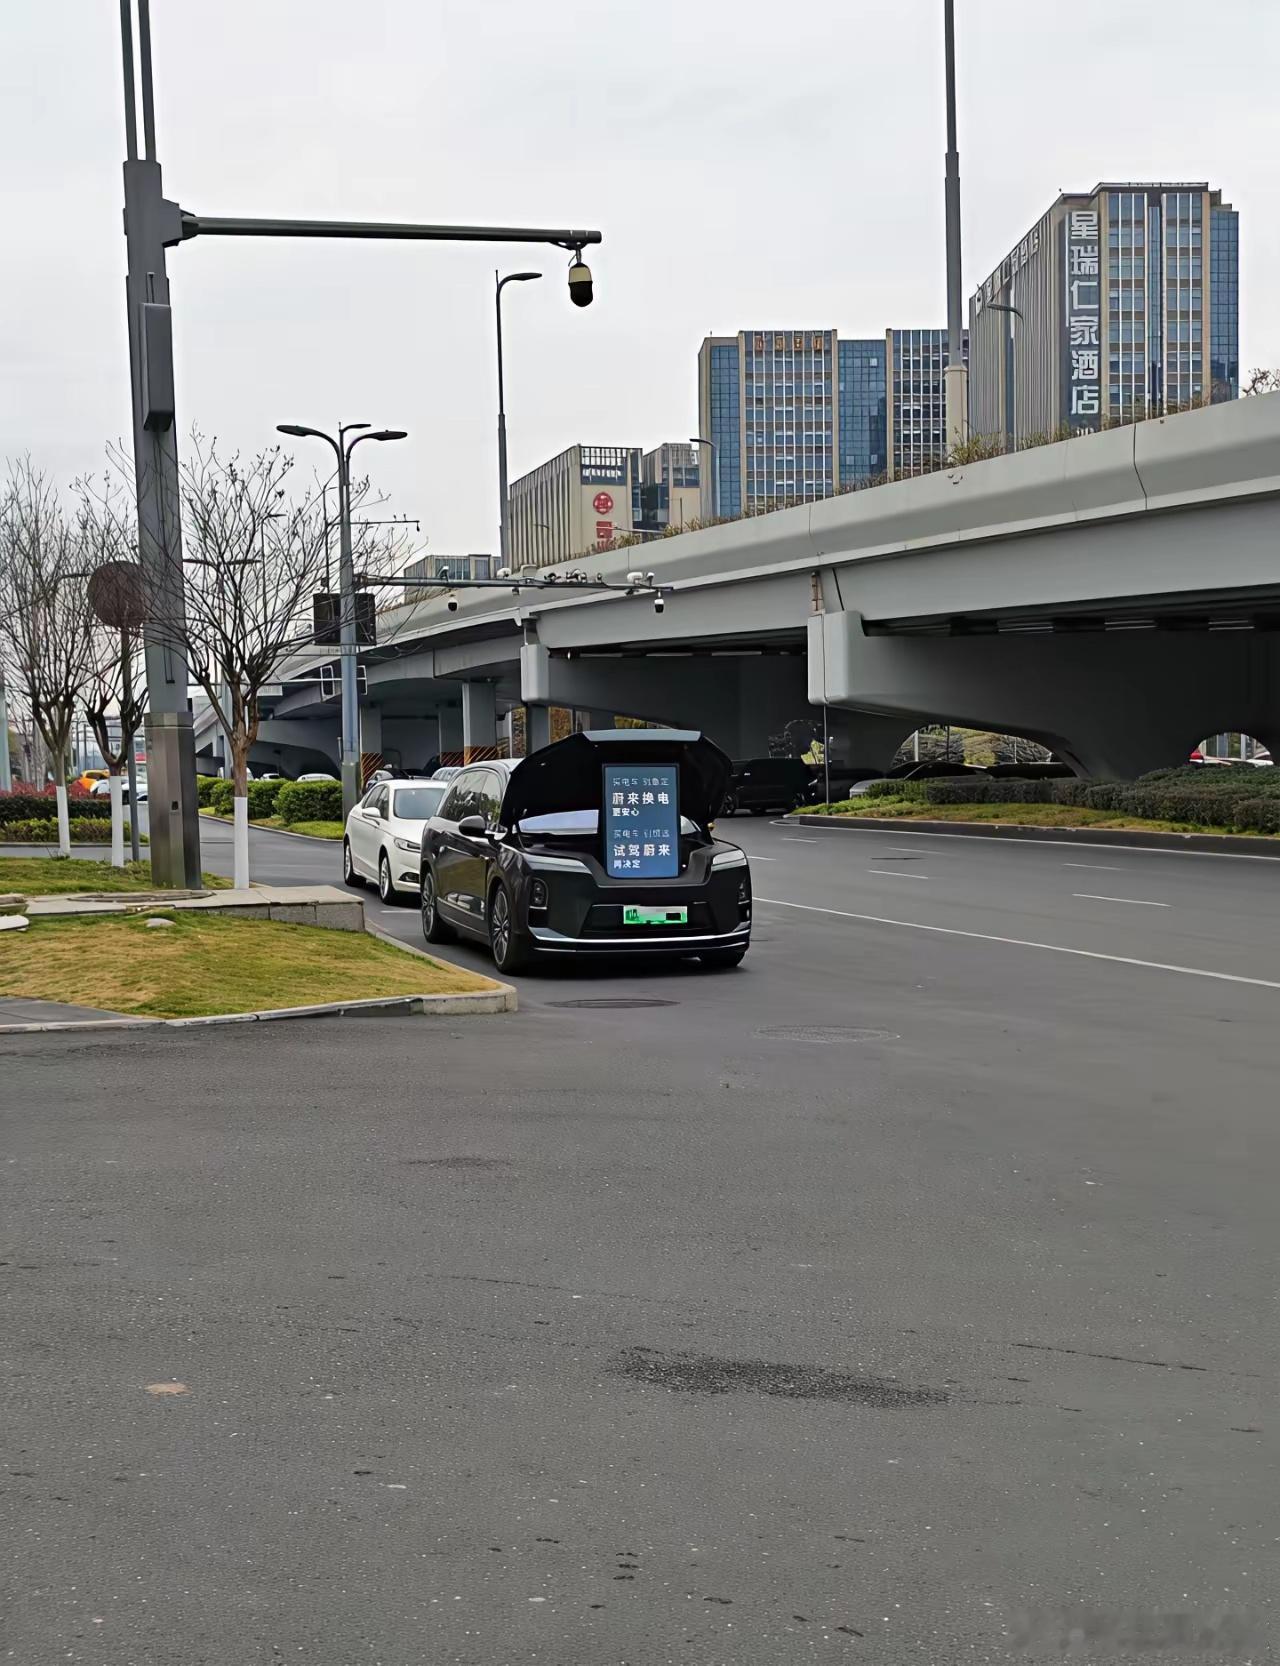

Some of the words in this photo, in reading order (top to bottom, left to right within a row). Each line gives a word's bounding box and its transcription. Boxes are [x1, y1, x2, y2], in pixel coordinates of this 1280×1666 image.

[612, 791, 669, 805] 蔚来换电
[613, 843, 671, 857] 试驾蔚来
